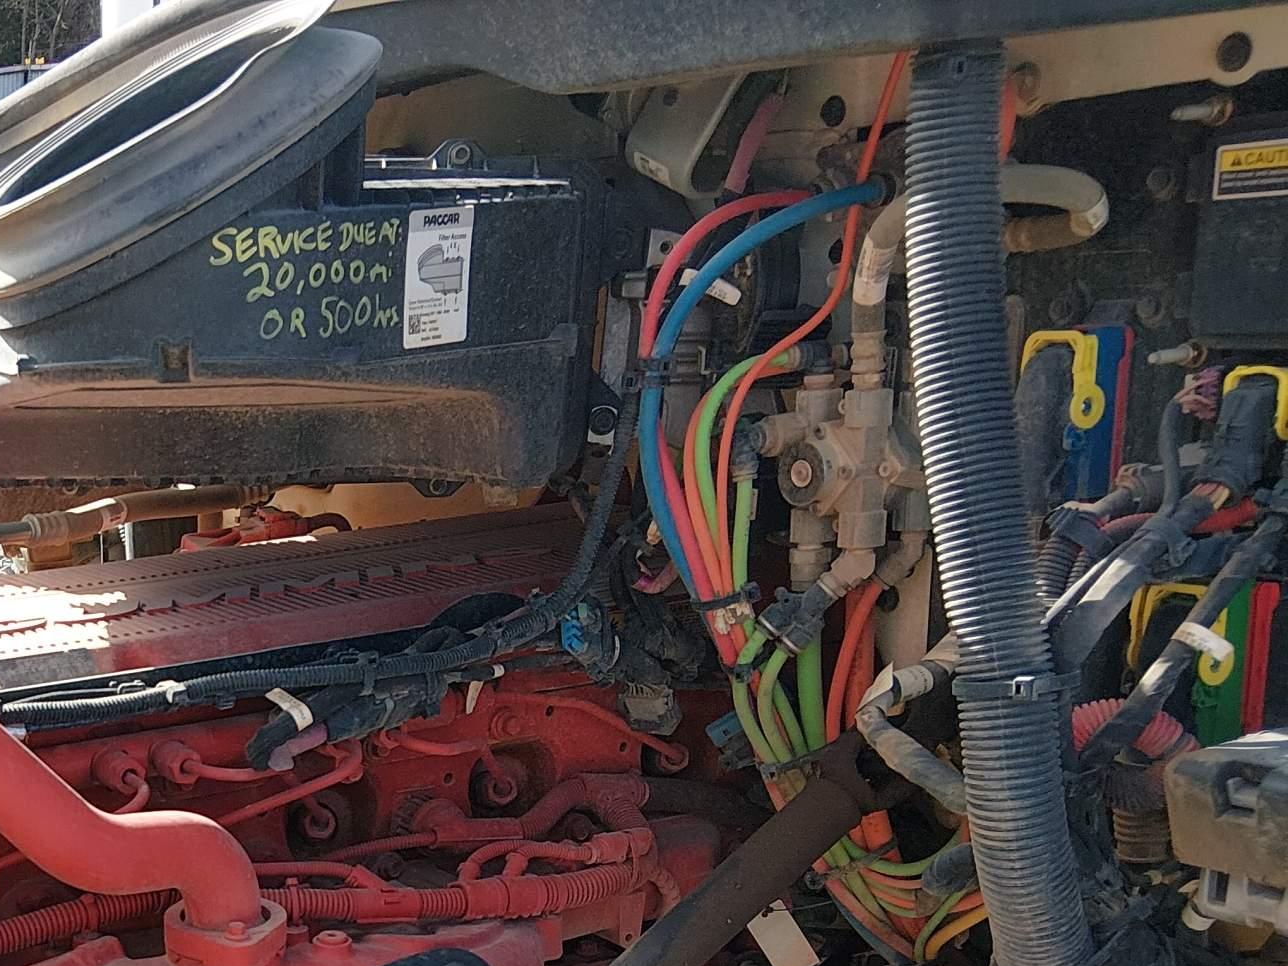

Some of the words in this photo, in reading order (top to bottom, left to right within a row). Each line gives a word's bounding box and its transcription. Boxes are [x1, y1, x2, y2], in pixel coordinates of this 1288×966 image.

[423, 212, 460, 227] PACCAR
[210, 220, 333, 266] SERVICE
[339, 221, 376, 251] DUE
